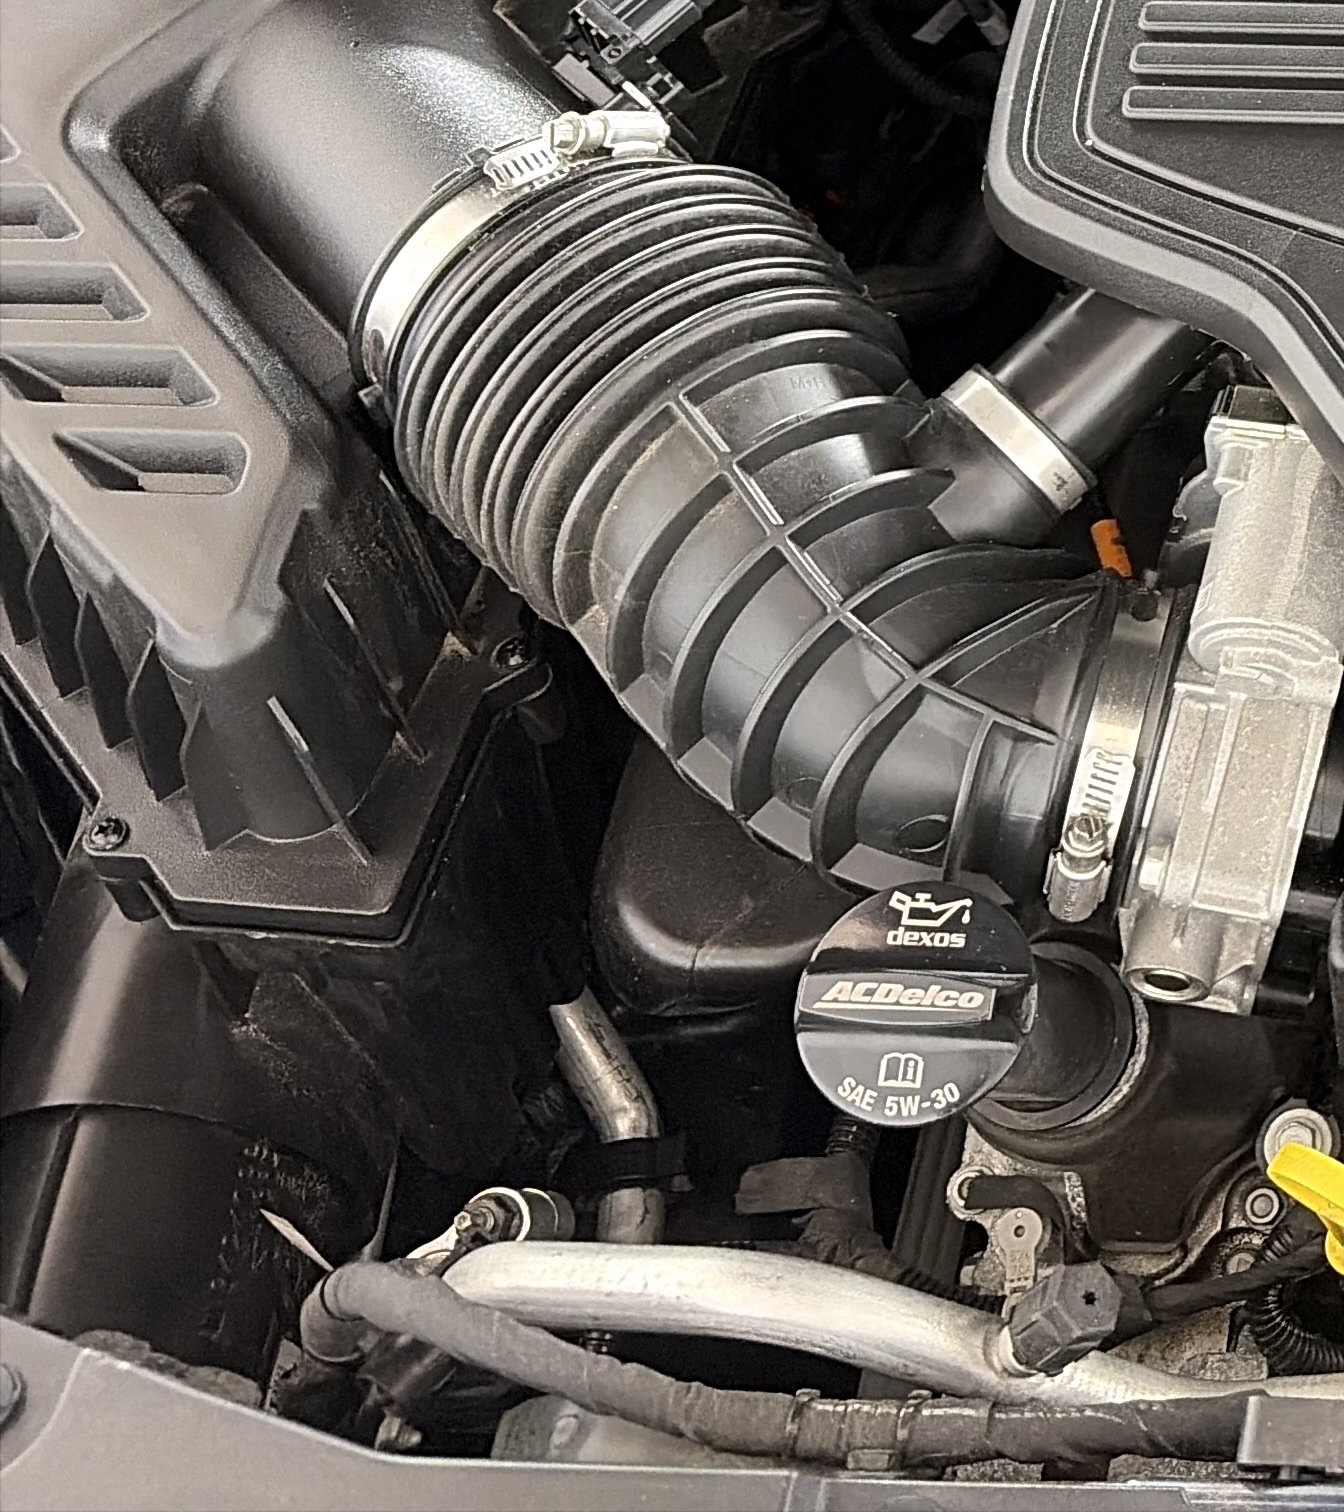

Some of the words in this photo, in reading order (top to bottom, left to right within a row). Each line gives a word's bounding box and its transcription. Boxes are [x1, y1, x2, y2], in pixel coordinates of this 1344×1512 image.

[886, 926, 967, 948] dexos
[821, 981, 985, 1009] ACDelco
[837, 1076, 878, 1112] SAE
[884, 1081, 961, 1116] 5W-30
